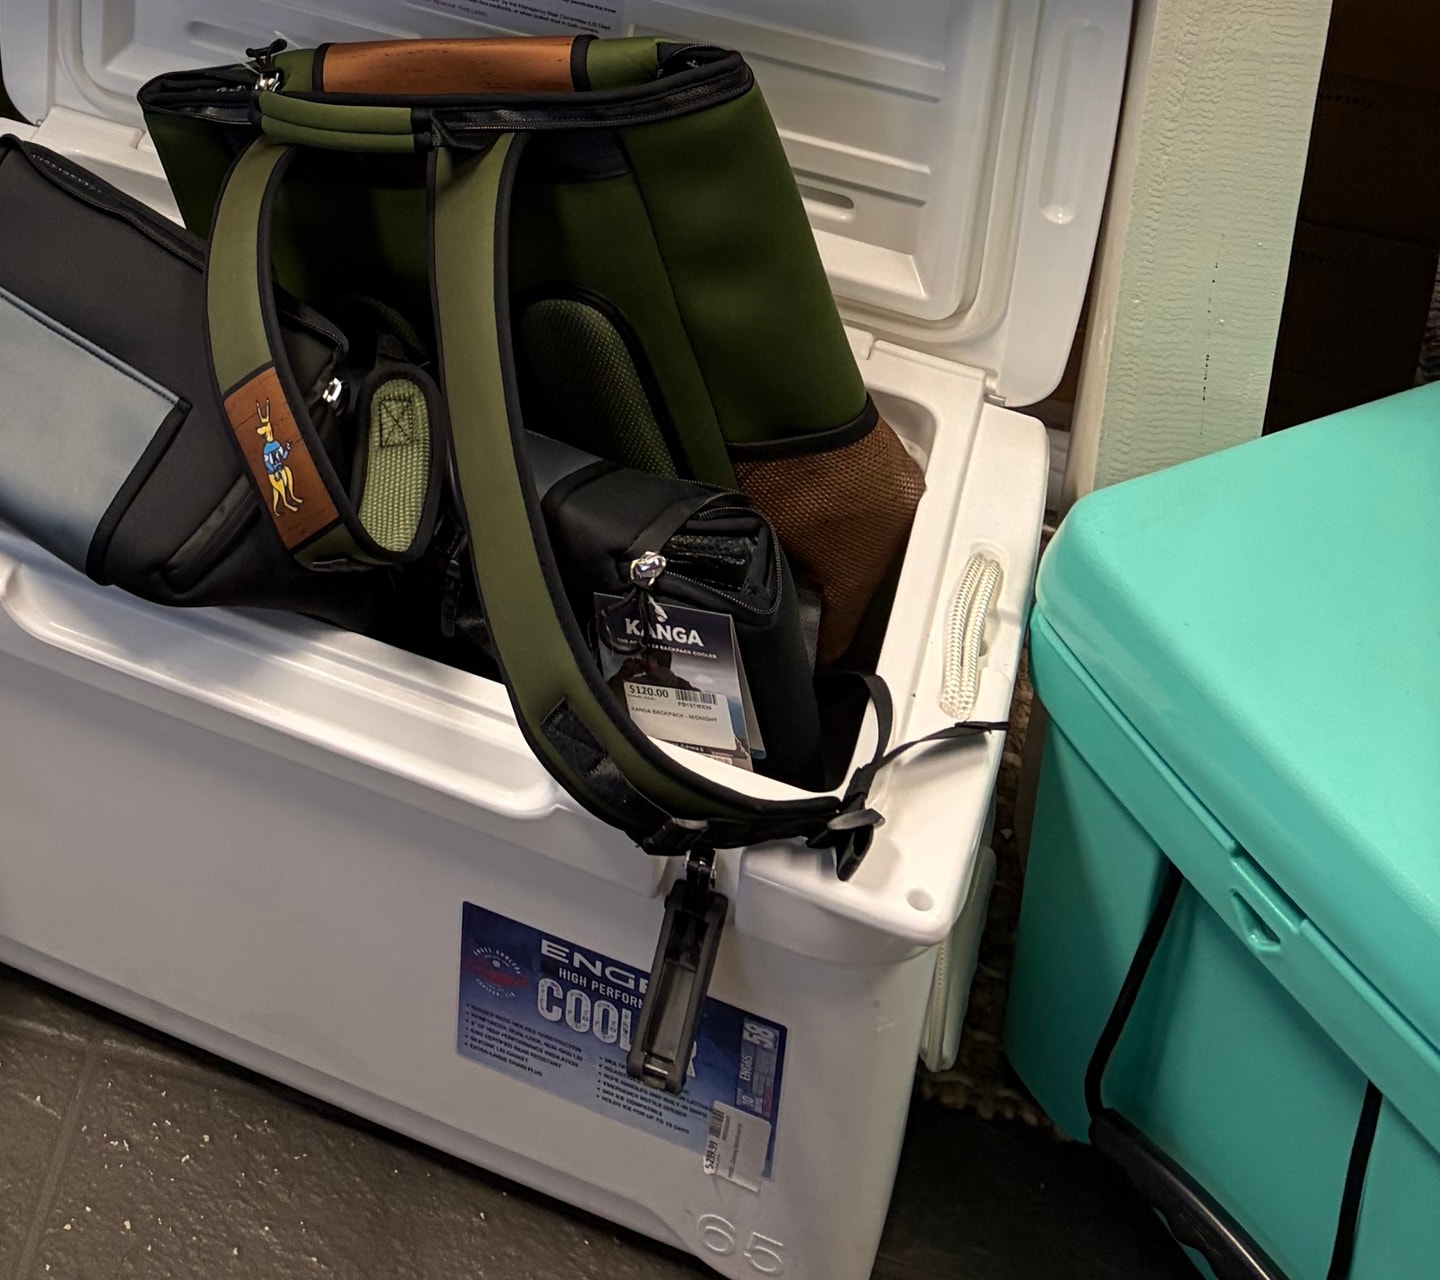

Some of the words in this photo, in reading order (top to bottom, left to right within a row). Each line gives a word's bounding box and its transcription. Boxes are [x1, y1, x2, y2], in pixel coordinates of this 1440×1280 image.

[660, 645, 691, 655] BACKPACK
[692, 651, 717, 659] COOLER
[629, 685, 669, 698] $120.00
[652, 710, 684, 718] BACKPACK
[688, 714, 717, 722] MIDNIGHT
[540, 939, 652, 994] ENGE
[559, 967, 587, 989] HIGH
[591, 981, 646, 1010] PERFOR
[697, 1214, 785, 1275] 65
